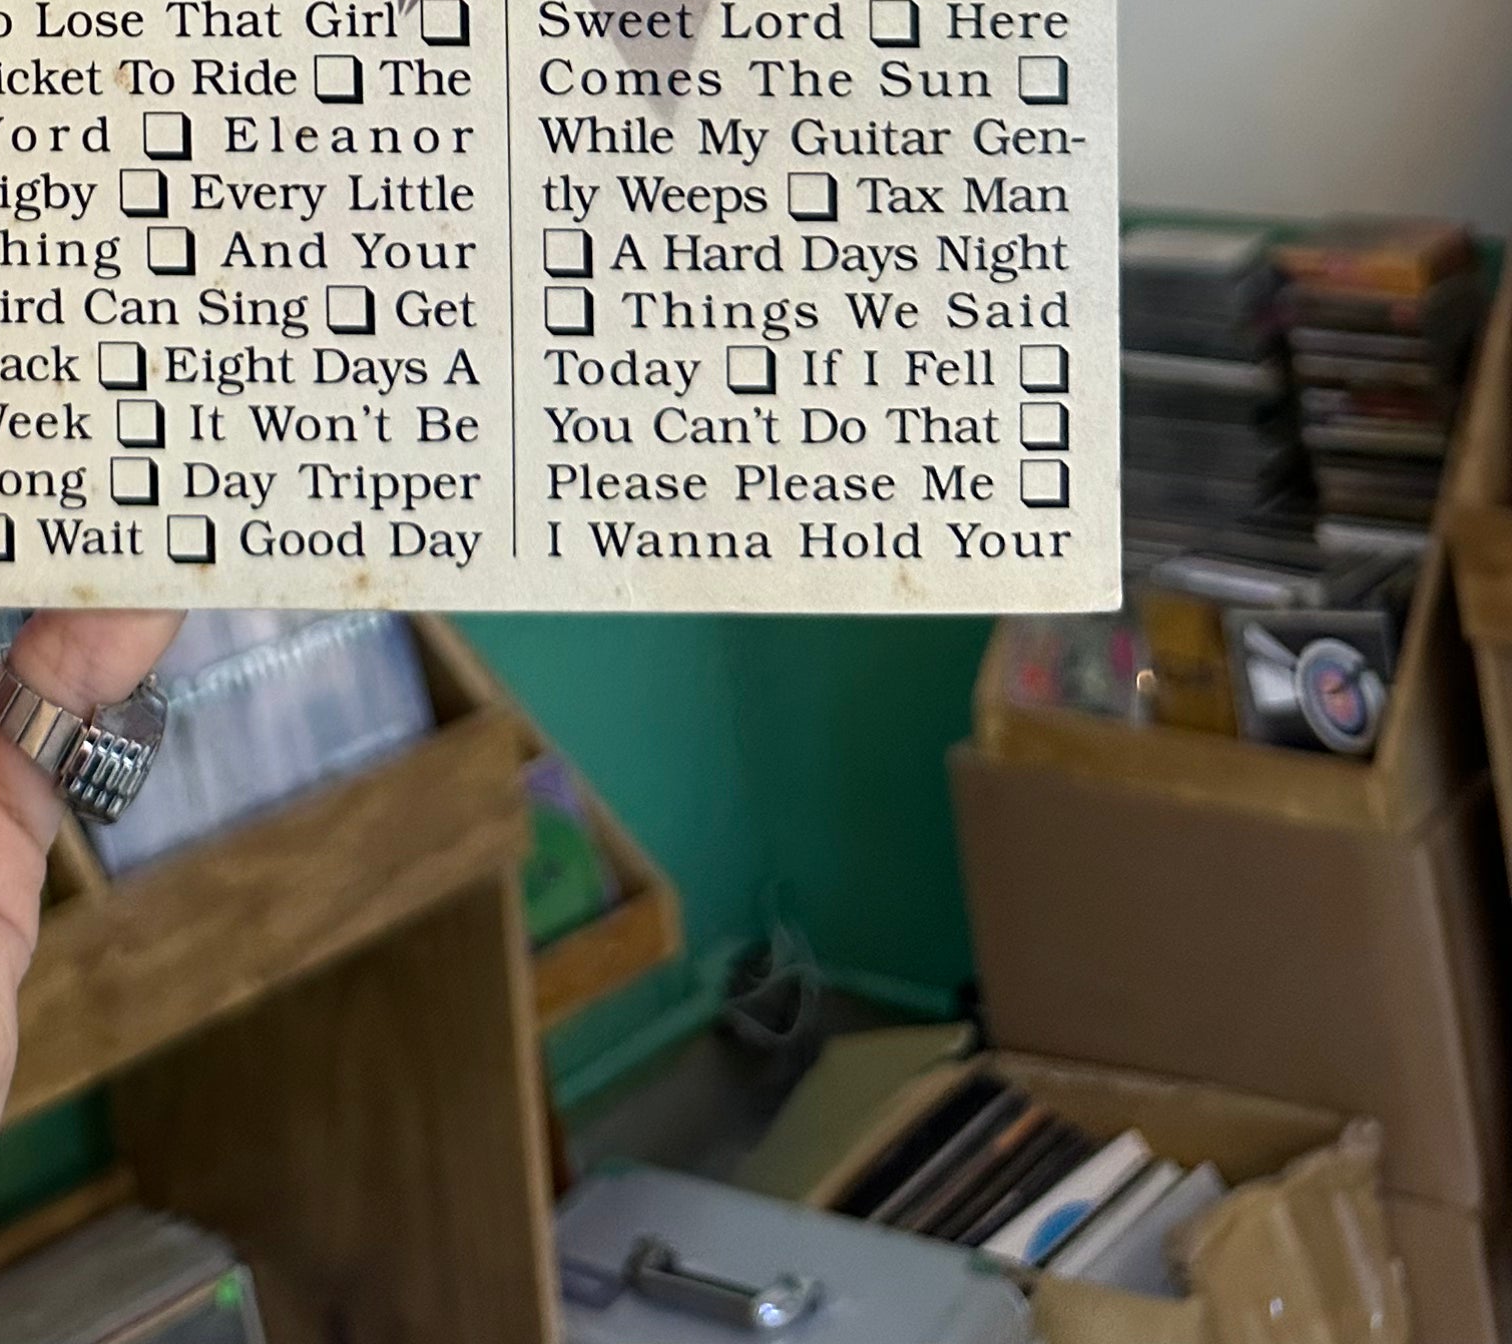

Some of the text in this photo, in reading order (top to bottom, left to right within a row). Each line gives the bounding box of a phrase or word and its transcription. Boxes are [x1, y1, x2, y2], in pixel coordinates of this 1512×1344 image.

[35, 1, 144, 38] Lose
[165, 0, 282, 38] That
[305, 0, 398, 39] Girl
[538, 0, 1069, 41] Sweet Lord Here
[224, 115, 474, 154] Eleanor
[538, 115, 1086, 167] While My Guitar Gen-
[190, 173, 327, 223] Every
[348, 174, 474, 212] Little
[609, 233, 1069, 284] A Hard Days Night
[84, 287, 180, 326] Can
[198, 288, 309, 340] Sing
[395, 289, 477, 328] Get
[621, 290, 1070, 342] Things We Said
[190, 404, 226, 442] It
[248, 404, 392, 443] Won't
[416, 406, 479, 443] Be
[543, 406, 1001, 445] You Can't Do That
[36, 518, 483, 569] Wait Good Day
[547, 521, 1072, 560] I Wanna Hold Your
